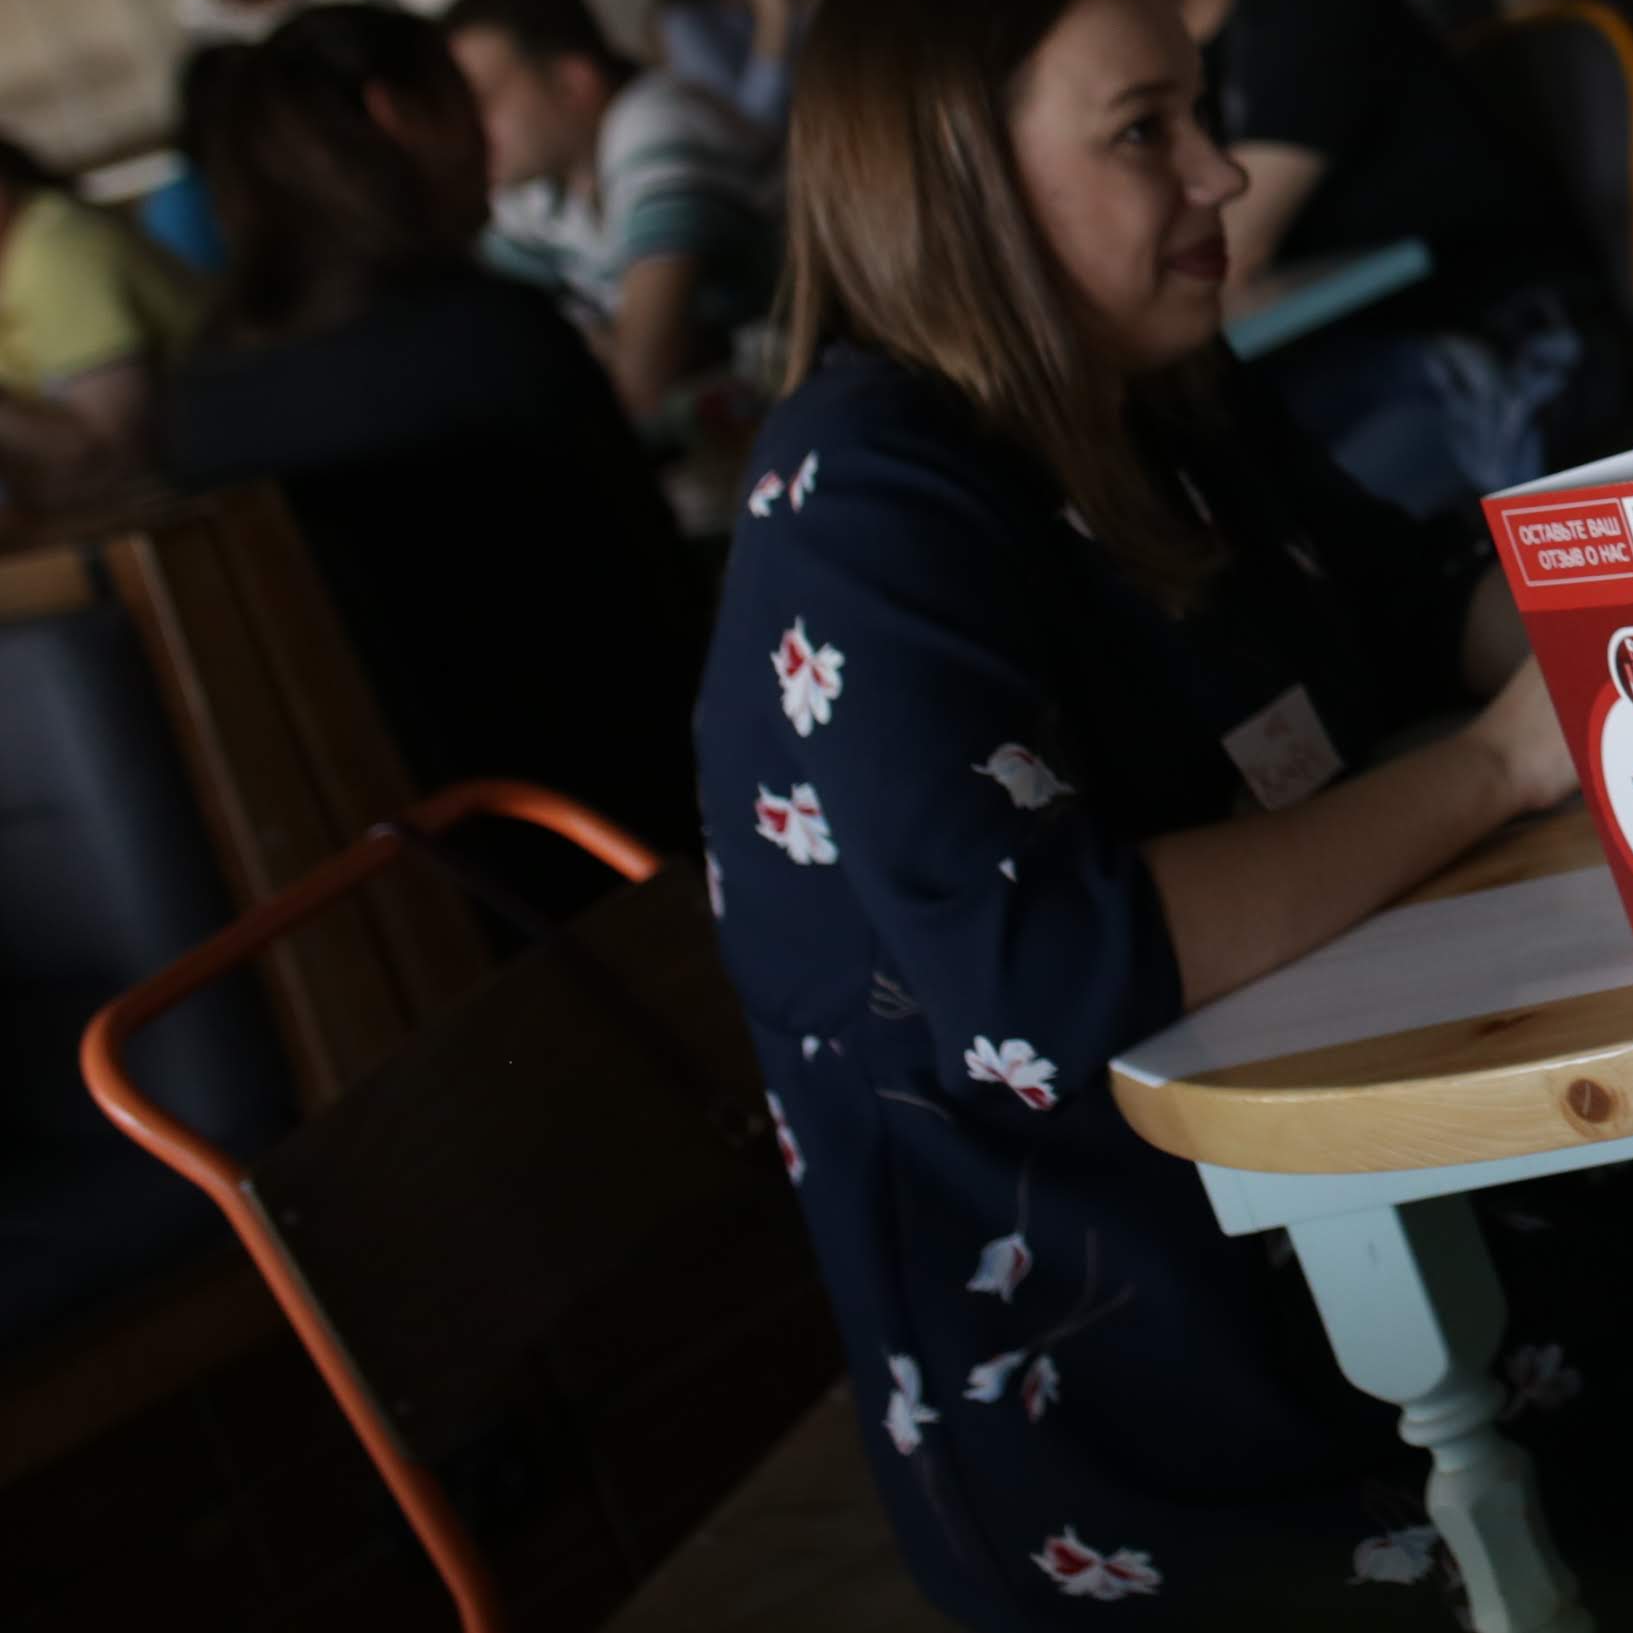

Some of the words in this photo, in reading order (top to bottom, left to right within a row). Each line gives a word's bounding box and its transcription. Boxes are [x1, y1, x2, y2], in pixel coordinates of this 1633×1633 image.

[1519, 521, 1586, 545] ОСТАВЬТЕ
[1588, 517, 1621, 537] ВАШ
[1539, 547, 1585, 570] ОТЗЫВ
[1587, 547, 1599, 565] О
[1601, 543, 1630, 562] НАС
